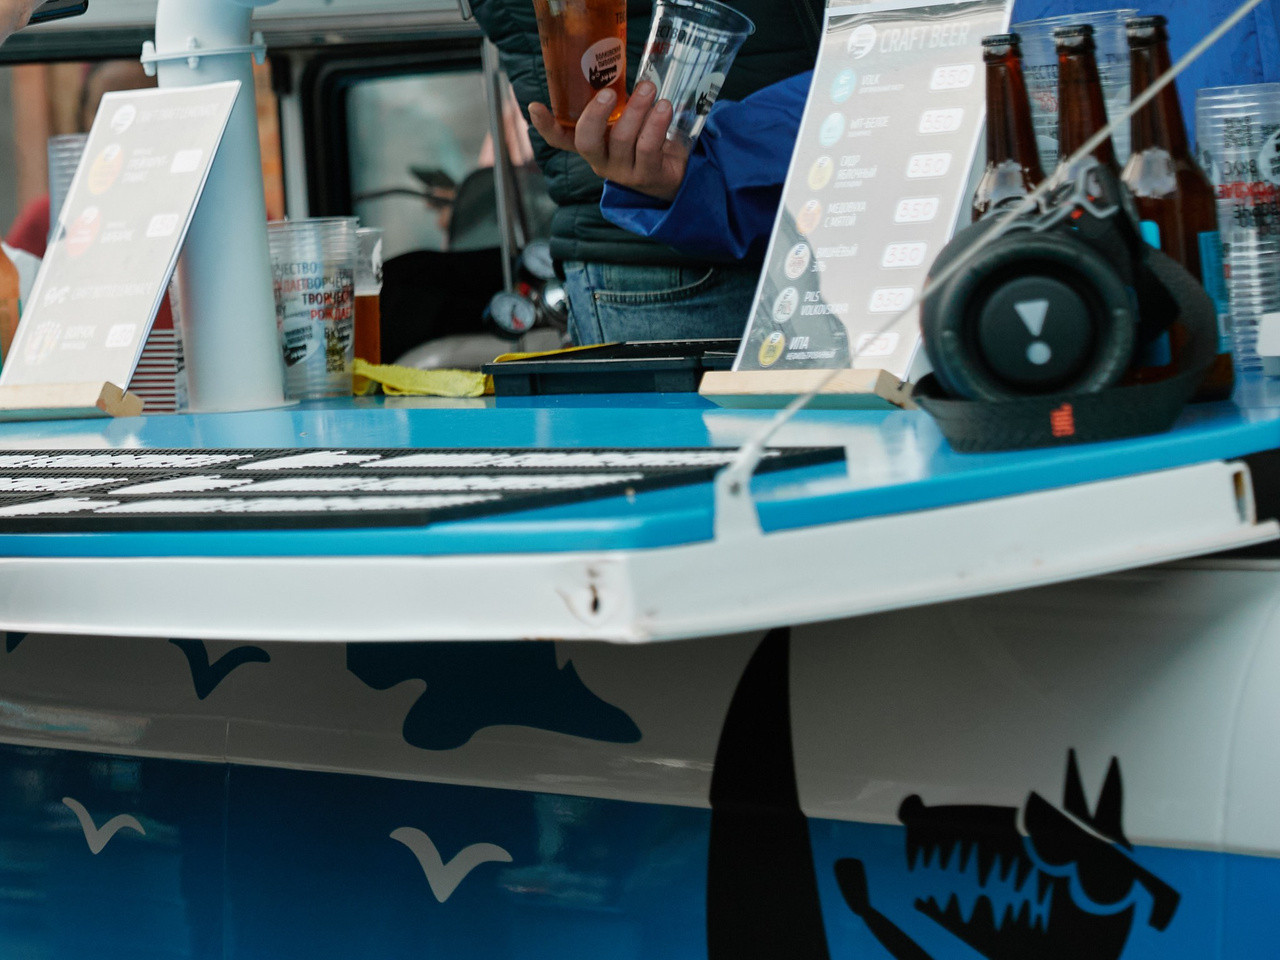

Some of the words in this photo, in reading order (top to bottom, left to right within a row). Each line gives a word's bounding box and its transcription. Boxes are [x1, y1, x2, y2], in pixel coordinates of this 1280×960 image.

[880, 26, 929, 53] CRAFT
[929, 23, 970, 49] BEER
[900, 201, 933, 218] 350
[886, 247, 921, 264] 350
[804, 291, 820, 302] PILS
[873, 292, 906, 309] 350
[789, 336, 809, 350] ИПА
